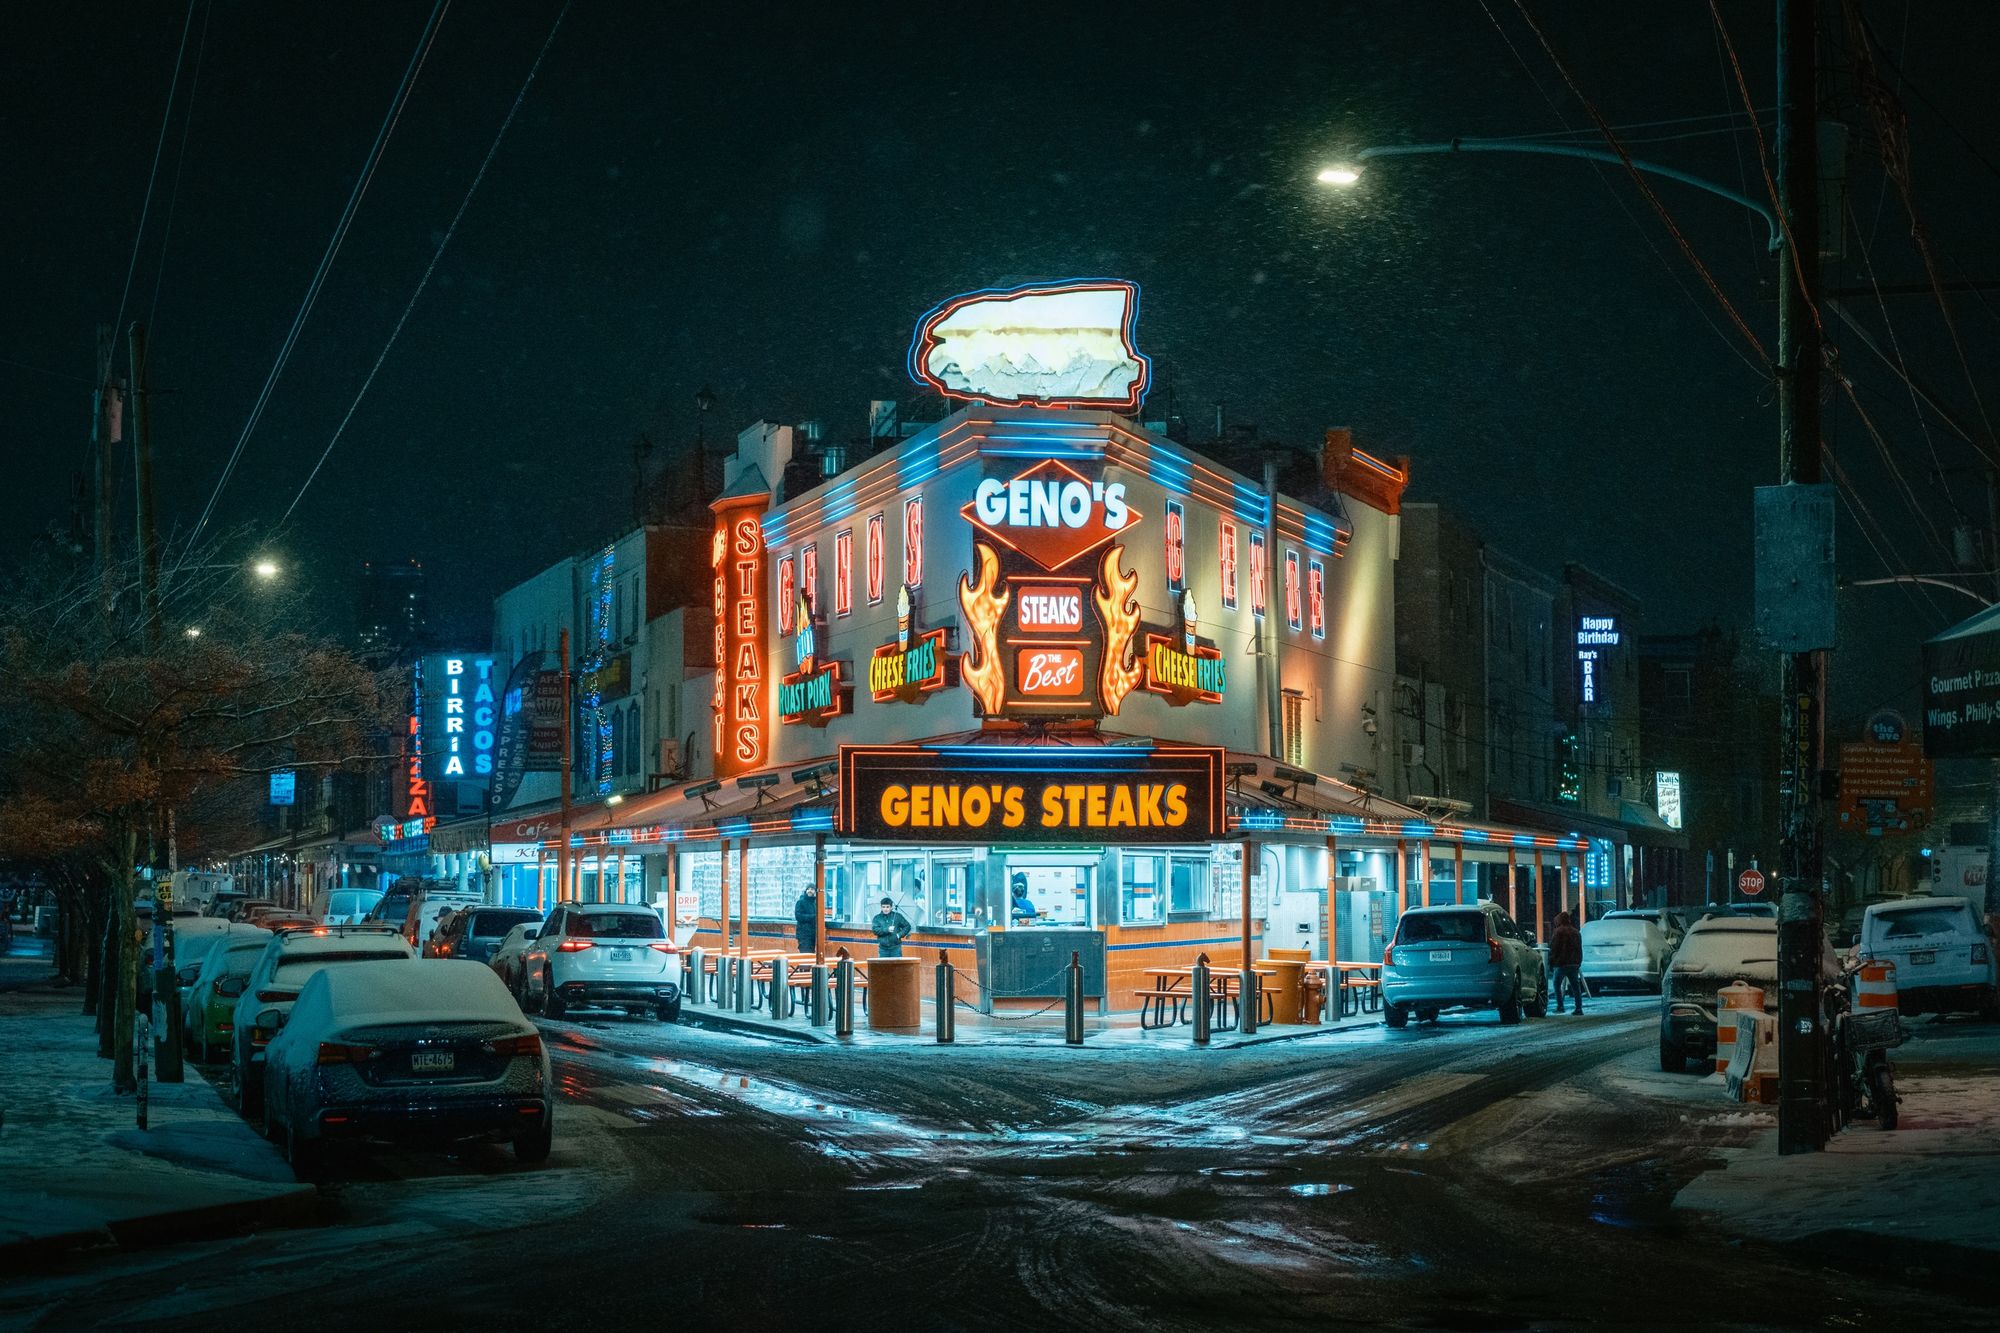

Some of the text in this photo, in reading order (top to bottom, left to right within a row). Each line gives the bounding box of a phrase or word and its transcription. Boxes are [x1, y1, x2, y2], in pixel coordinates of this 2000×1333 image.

[975, 477, 1129, 530] GENO'S
[1019, 594, 1081, 627] STEAKS
[1582, 616, 1614, 631] Happy
[735, 518, 760, 763] STEAKS
[1577, 631, 1620, 646] Birthday
[1578, 650, 1598, 660] Ray's
[869, 637, 936, 693] CHEESE FRIES
[1025, 657, 1077, 690] Best
[1047, 653, 1061, 663] THE
[1155, 643, 1227, 694] CHEESE FRIES
[779, 670, 832, 717] ROAST PORK
[1583, 661, 1594, 702] BAR
[1930, 673, 1973, 694] Gourmet
[474, 659, 495, 774] TACOS
[1872, 723, 1895, 733] the
[1927, 708, 1958, 729] Wings
[880, 783, 1188, 829] GENO'S STEAKS
[1739, 877, 1763, 888] STOP
[678, 896, 698, 905] DRIP
